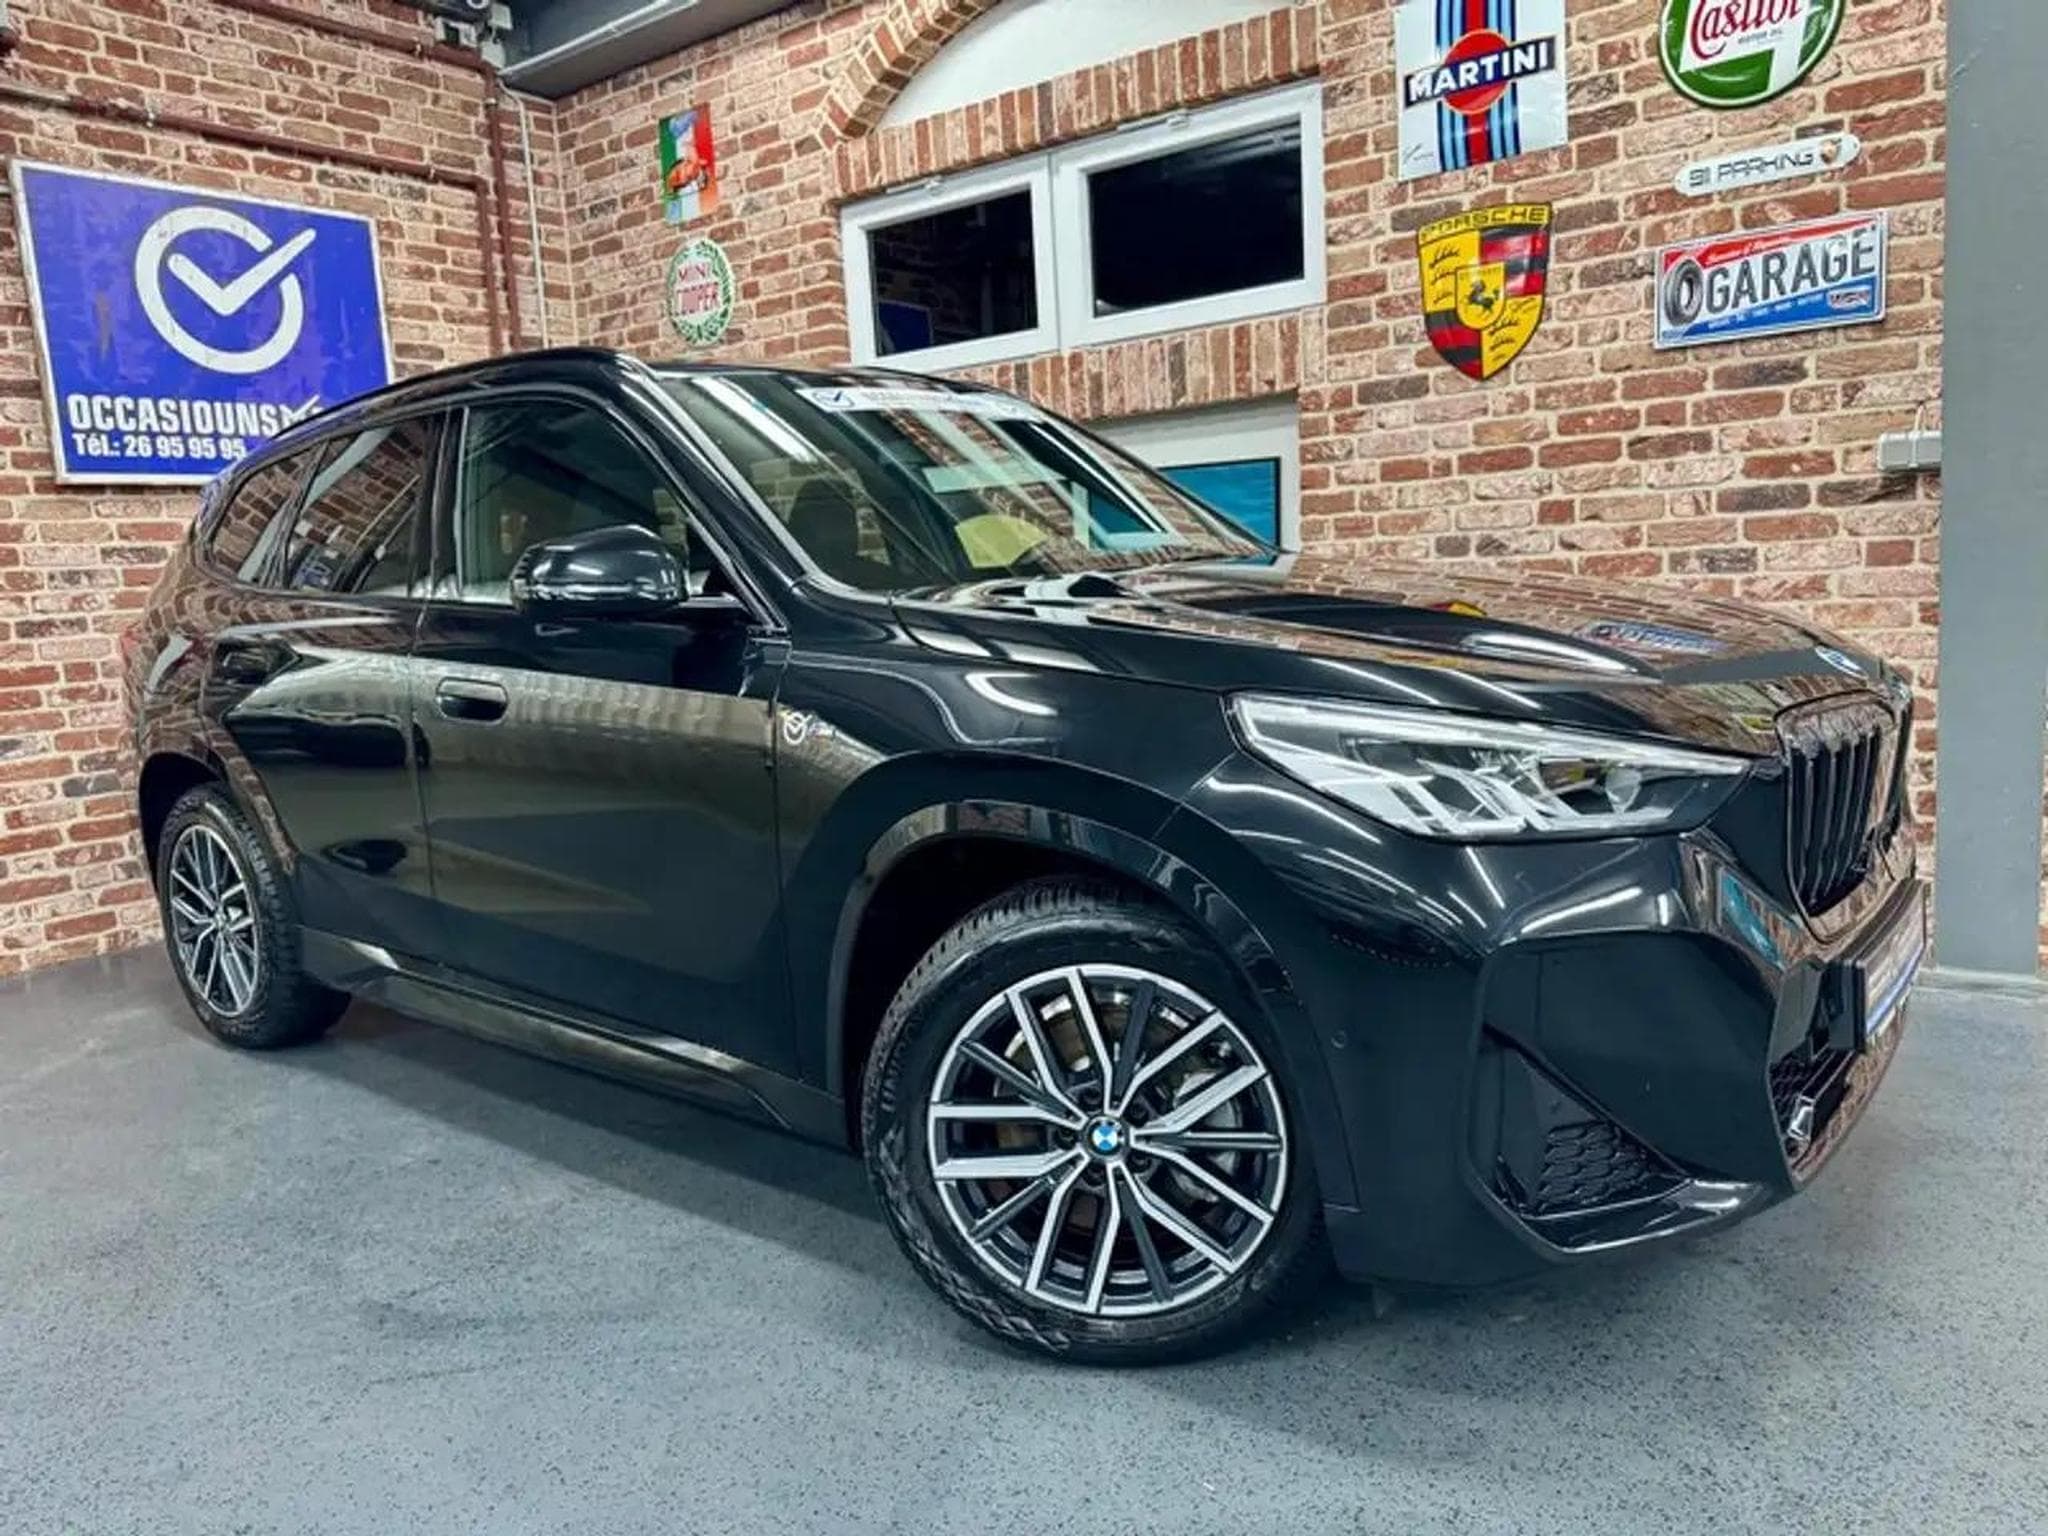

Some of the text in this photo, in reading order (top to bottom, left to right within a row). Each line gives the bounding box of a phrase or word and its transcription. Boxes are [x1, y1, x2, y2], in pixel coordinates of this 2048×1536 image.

[1690, 0, 1801, 59] Castro
[1407, 41, 1549, 102] MARTINI
[1718, 152, 1814, 180] PARKING
[1421, 206, 1546, 242] PORSCHE
[1705, 227, 1876, 314] GARAGE
[122, 435, 152, 458] 26
[156, 436, 185, 459] 95
[188, 437, 217, 460] 95
[219, 437, 247, 461] 95
